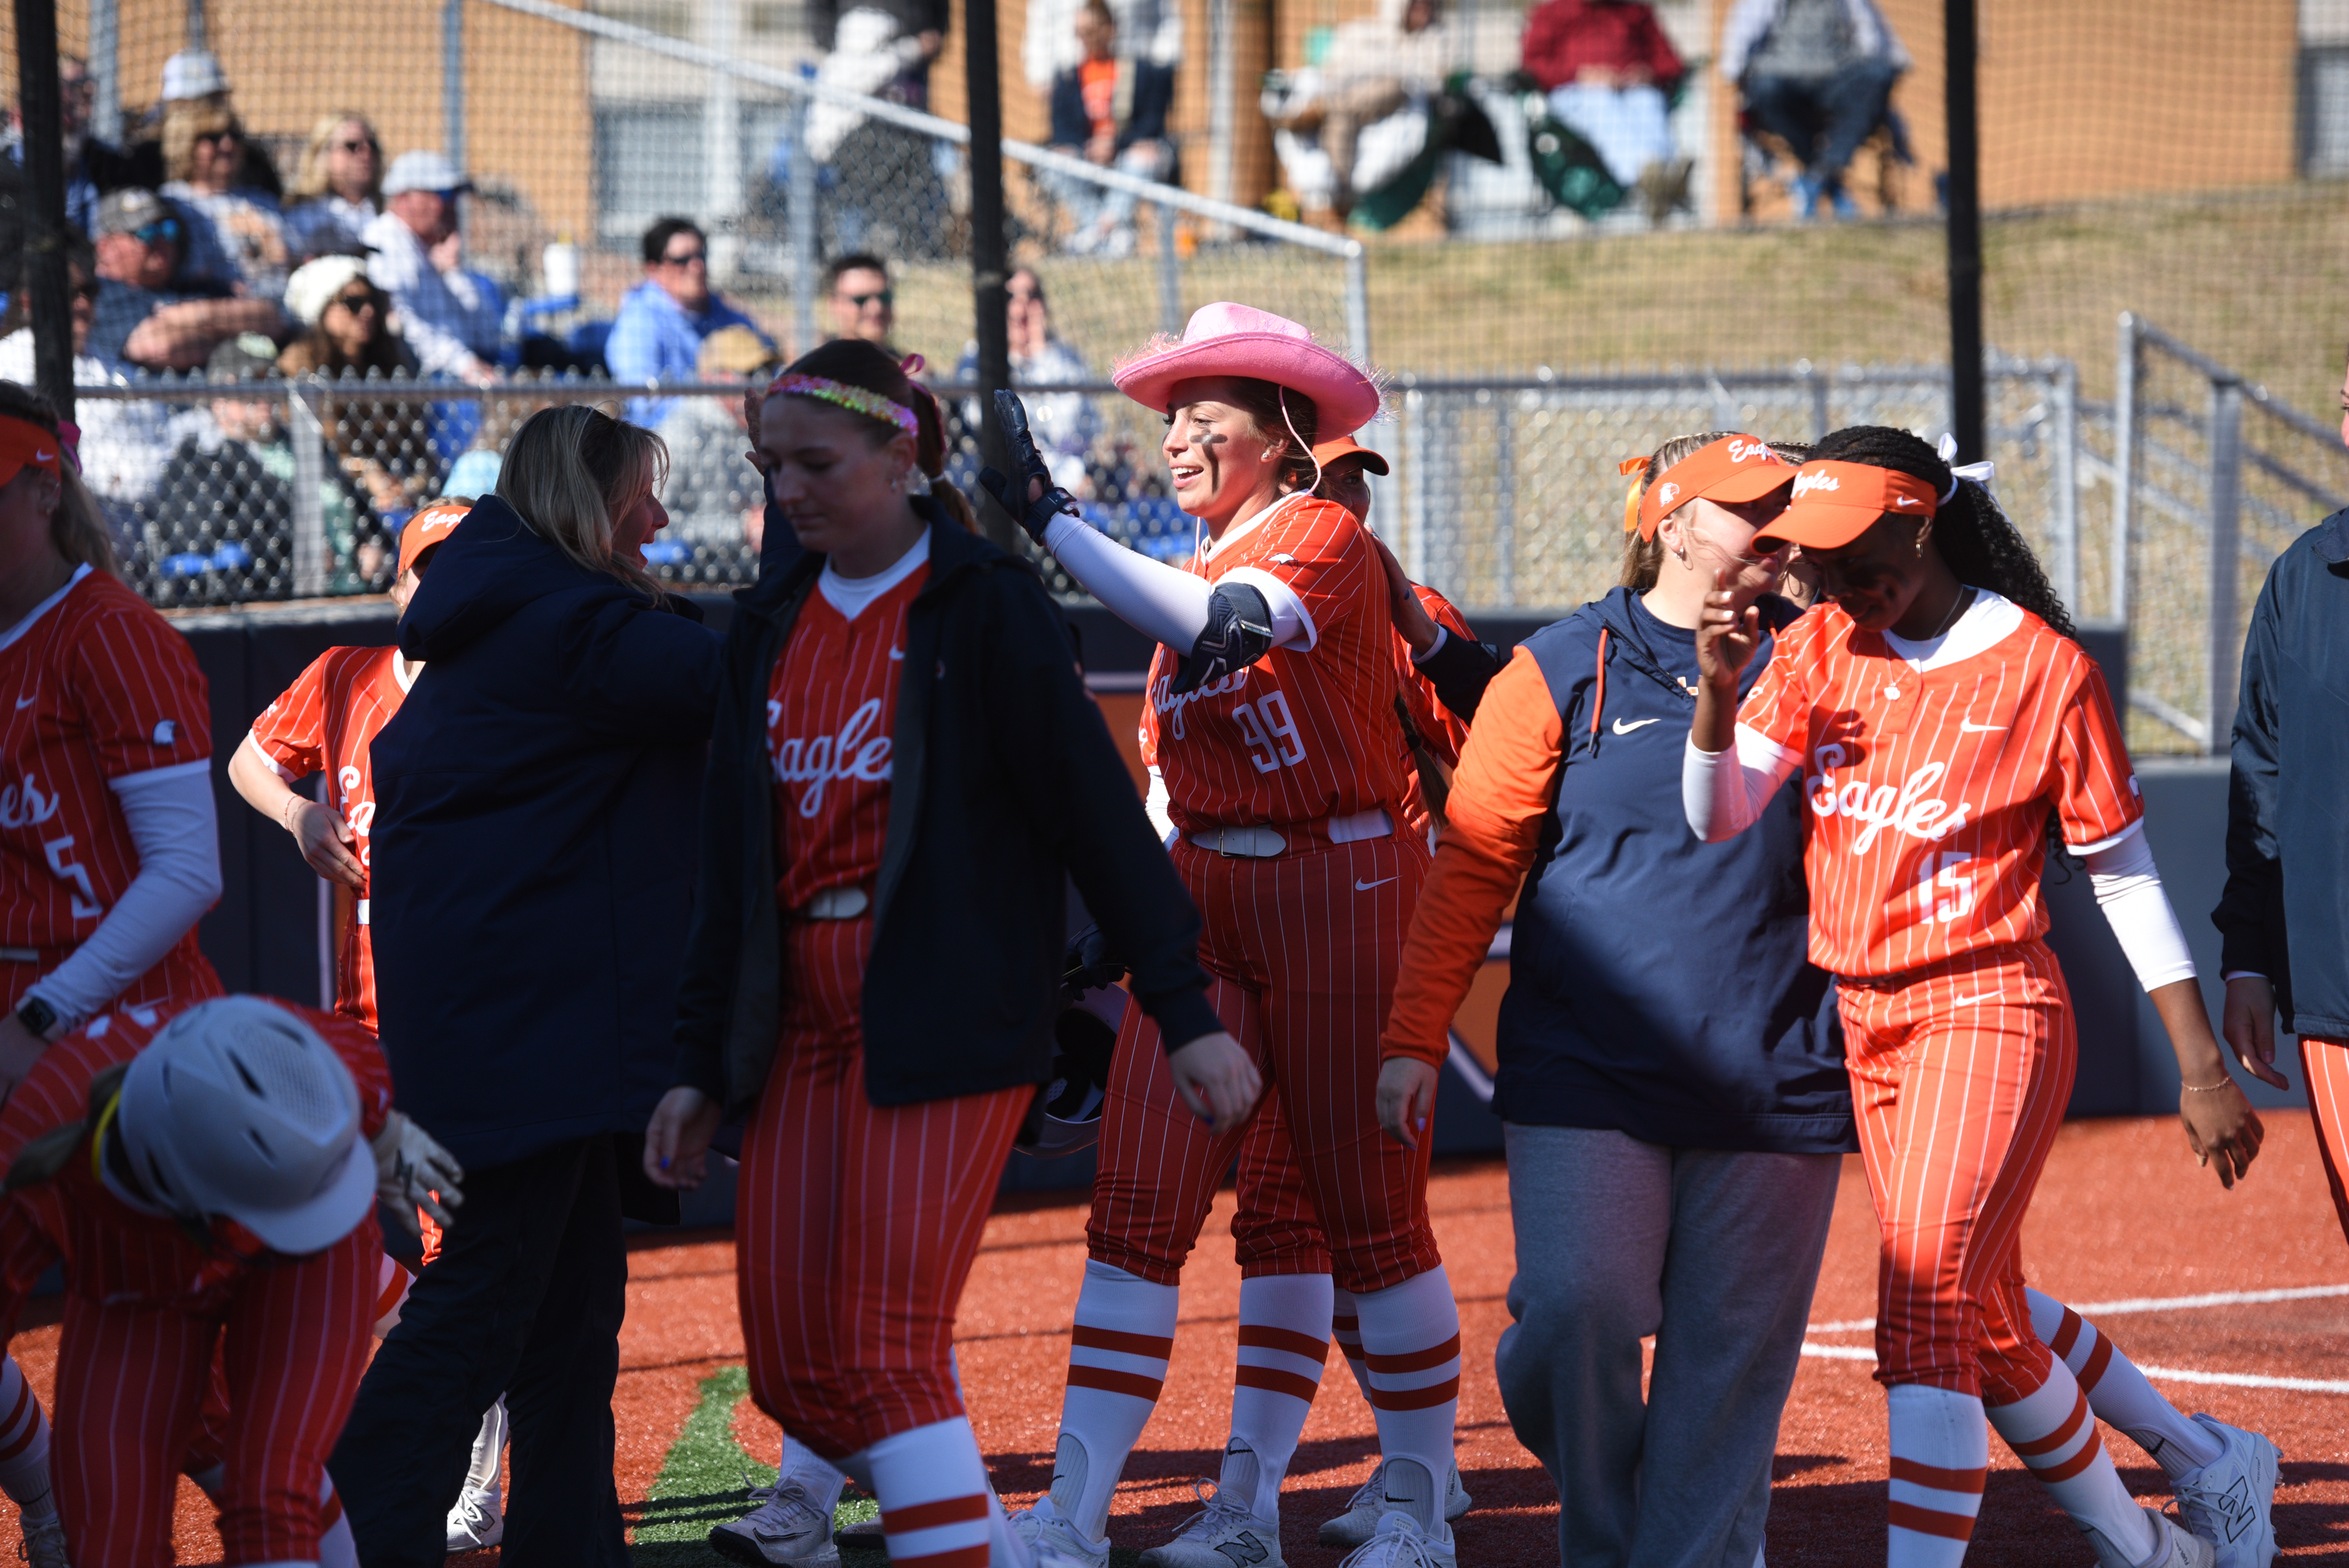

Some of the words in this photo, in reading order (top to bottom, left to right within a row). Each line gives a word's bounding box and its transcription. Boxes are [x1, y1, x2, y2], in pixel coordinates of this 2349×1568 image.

[767, 697, 894, 818] agle
[1231, 690, 1307, 775] 99
[1806, 743, 1972, 856] Eagles
[44, 834, 104, 919] 5
[1918, 850, 1973, 923] 15
